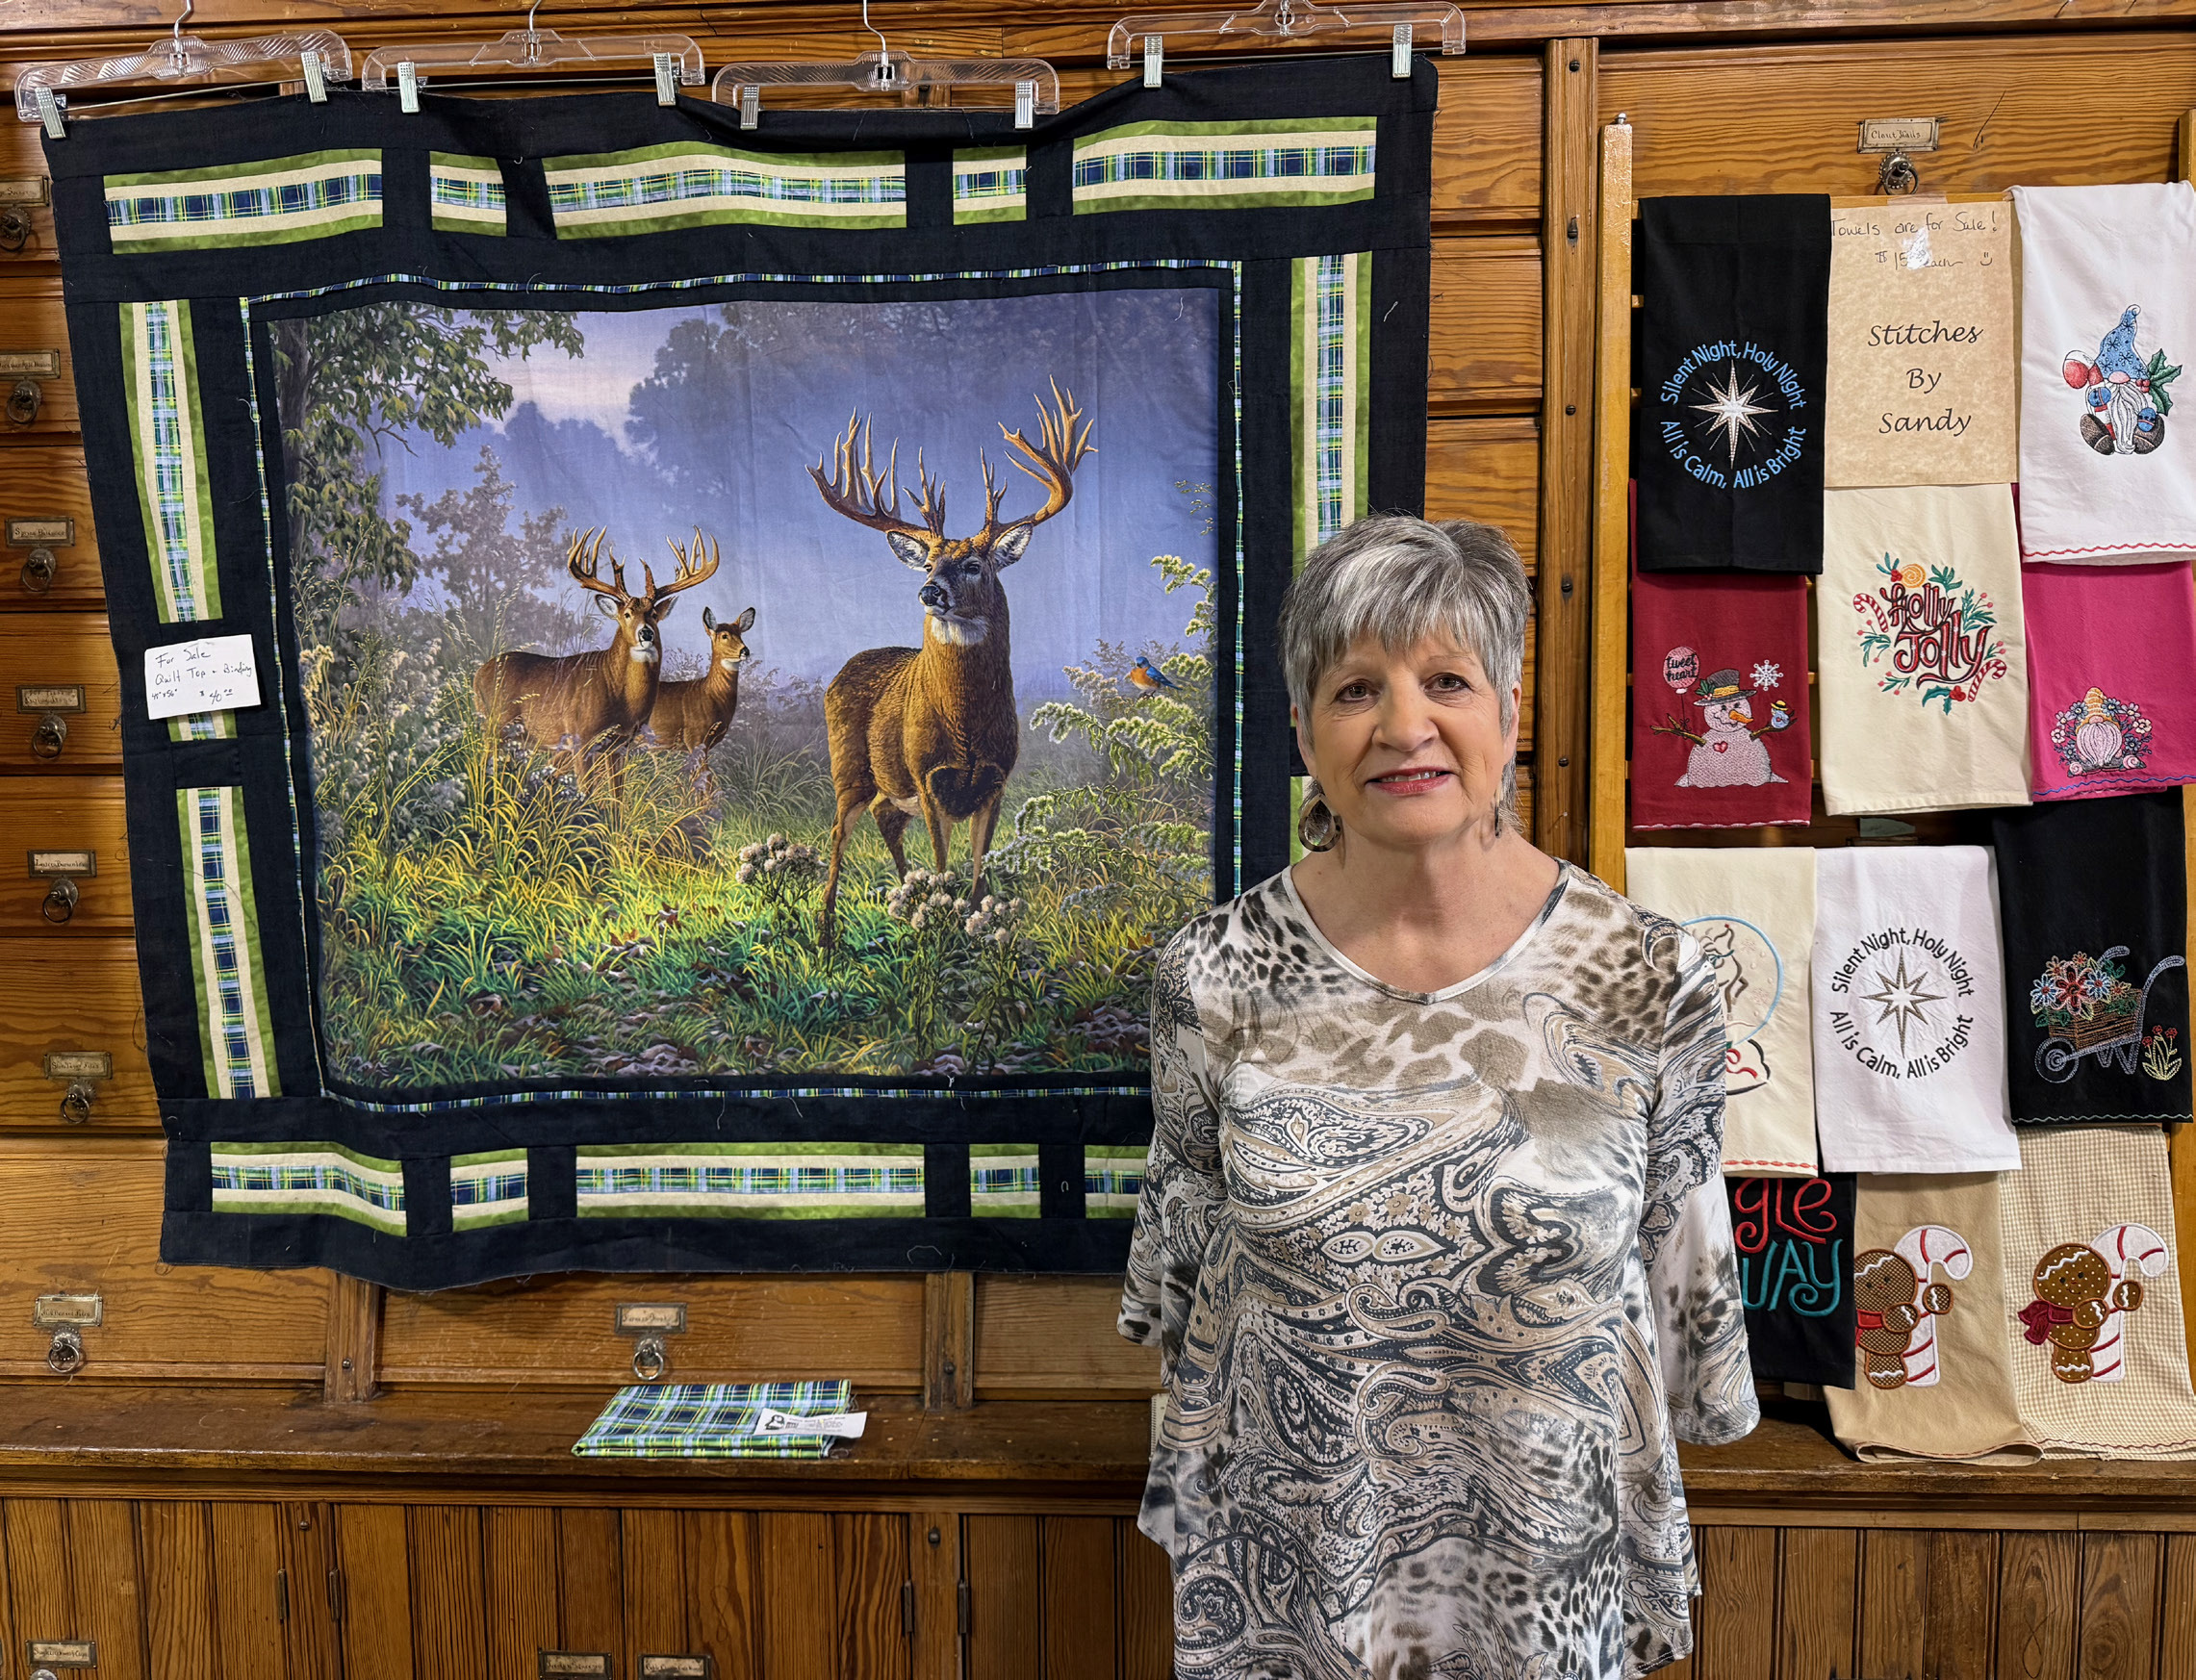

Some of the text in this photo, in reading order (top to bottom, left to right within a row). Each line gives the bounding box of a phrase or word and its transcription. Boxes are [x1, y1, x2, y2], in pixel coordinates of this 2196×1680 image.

[1871, 130, 1896, 139] Clout
[1831, 217, 1881, 237] Towels
[1894, 223, 1919, 234] are
[1925, 213, 1944, 232] for
[1868, 319, 1984, 347] Stitches
[1660, 340, 1807, 410] Silent Night, Holy Night
[1905, 368, 1942, 395] By
[1878, 407, 1972, 438] Sandy
[1660, 421, 1807, 489] All is Calm, All is Bright
[1879, 583, 1956, 634] Holly
[155, 648, 212, 669] For Sale
[1665, 653, 1698, 669] tweet
[1893, 610, 1995, 690] Jolly
[155, 670, 181, 686] Quilt
[186, 667, 206, 679] Top
[223, 661, 252, 677] Binding
[1665, 667, 1699, 682] heart
[1831, 928, 1976, 997] Silent Night, Holy Night
[1829, 1011, 1974, 1080] All is Calm, All is Bright
